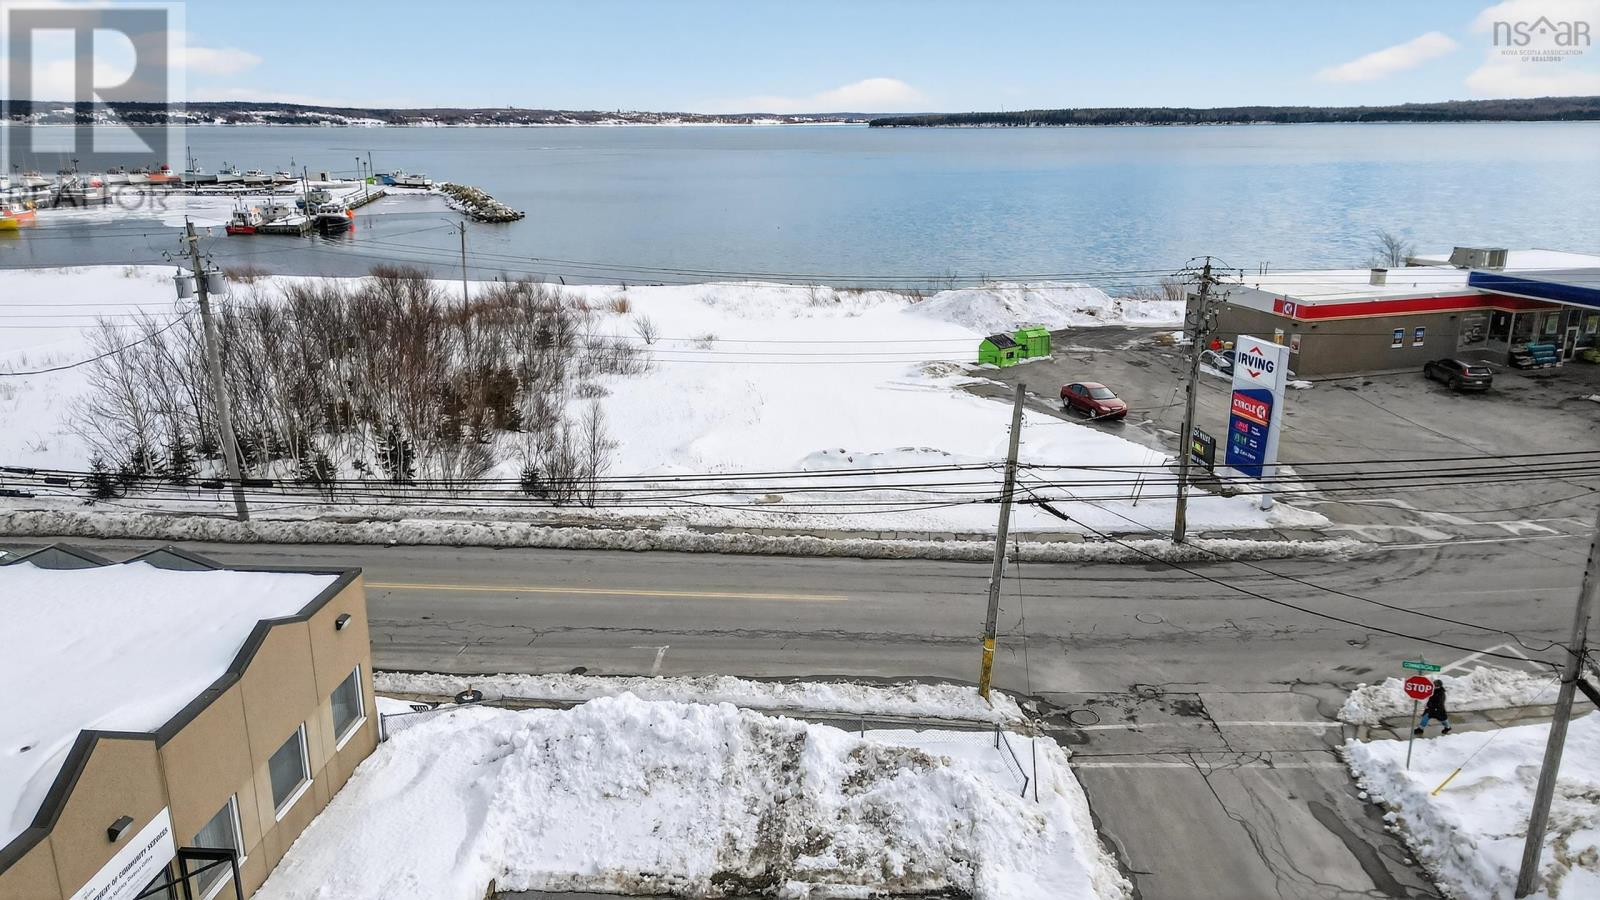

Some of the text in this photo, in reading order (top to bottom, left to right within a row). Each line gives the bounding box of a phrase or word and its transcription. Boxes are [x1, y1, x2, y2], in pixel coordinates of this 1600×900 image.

[1238, 351, 1274, 373] IRVING
[1233, 398, 1256, 414] CIRCLE
[1406, 682, 1432, 692] STOP
